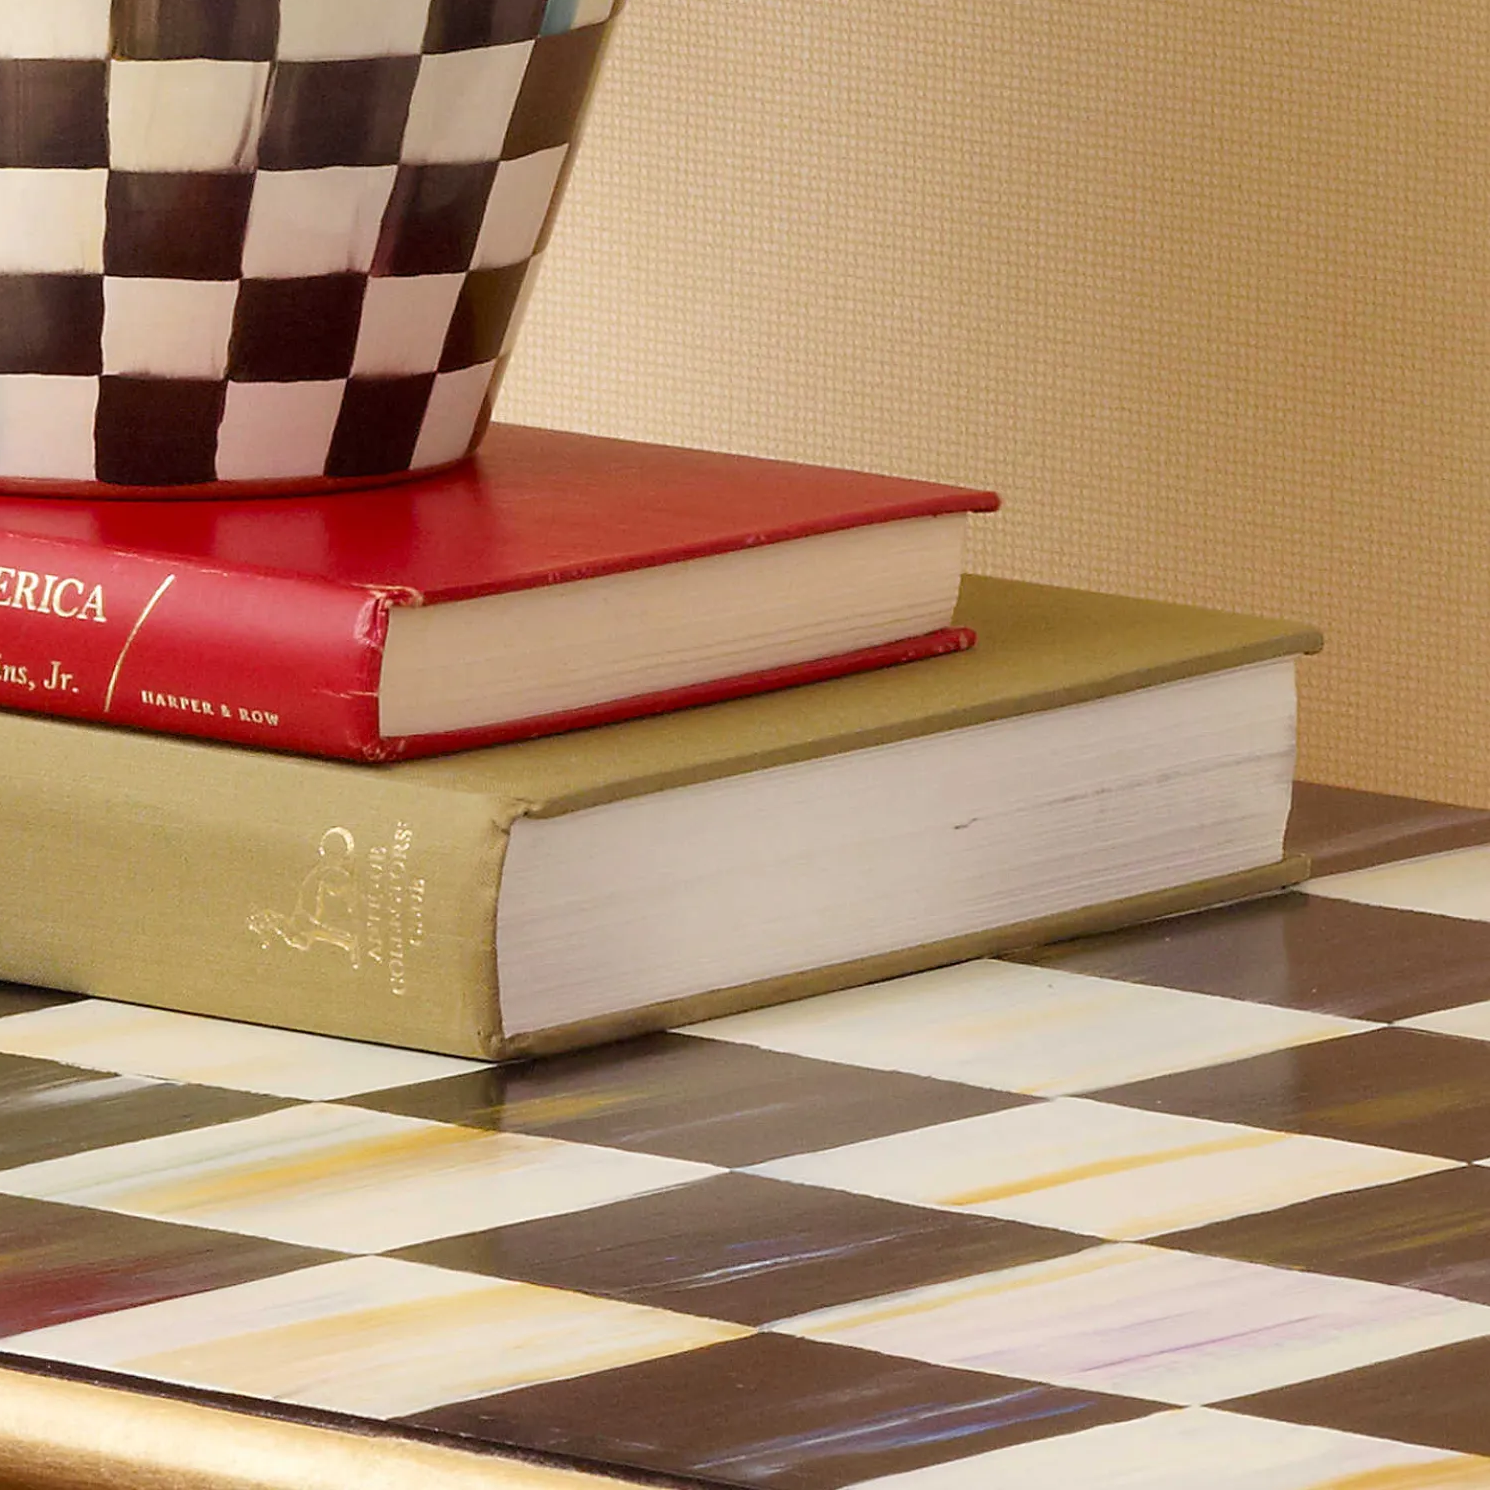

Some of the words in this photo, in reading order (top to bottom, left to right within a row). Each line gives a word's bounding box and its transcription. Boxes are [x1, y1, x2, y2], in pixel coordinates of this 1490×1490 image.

[44, 661, 78, 692] Jr.
[142, 690, 214, 715] HARPER
[220, 703, 232, 718] &
[239, 708, 279, 726] ROW
